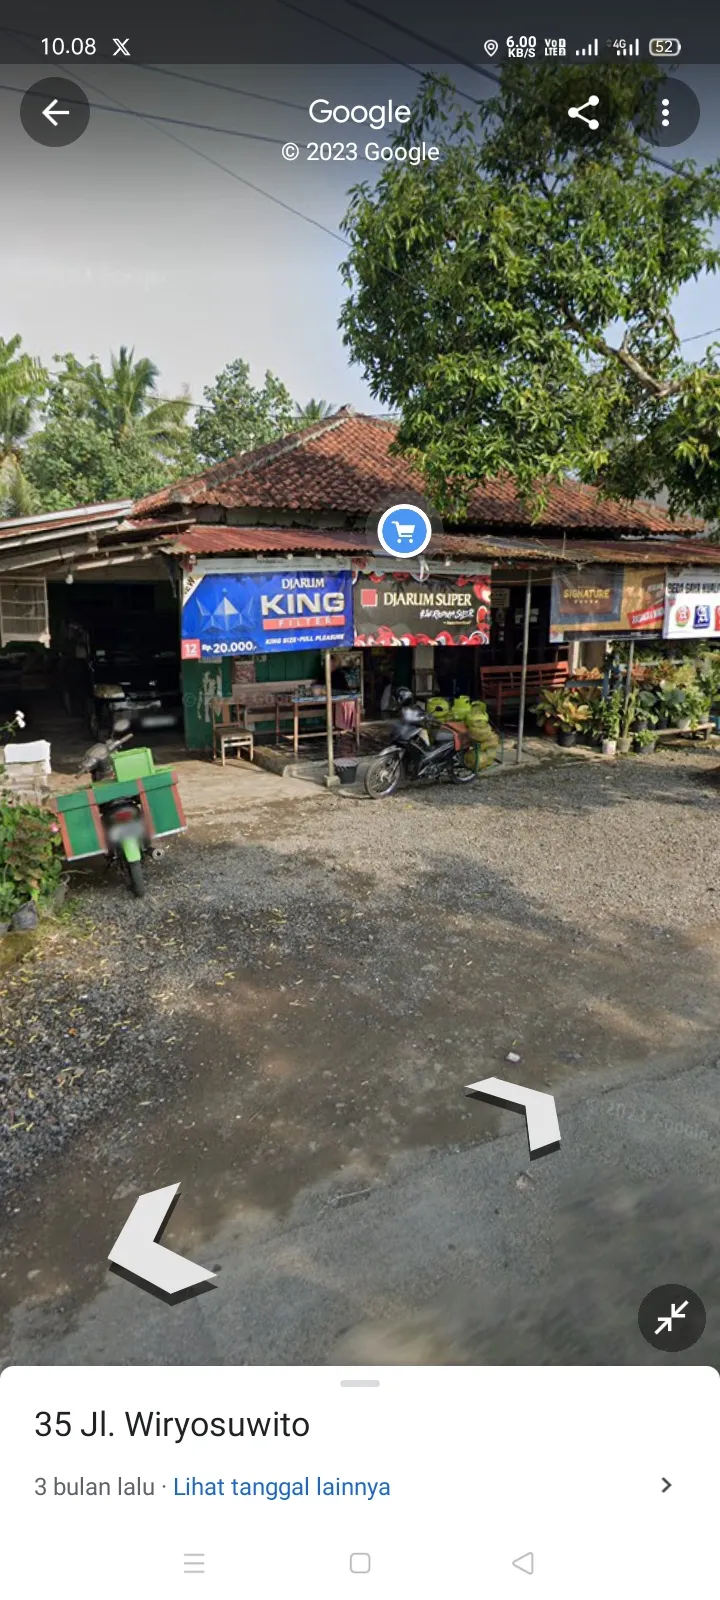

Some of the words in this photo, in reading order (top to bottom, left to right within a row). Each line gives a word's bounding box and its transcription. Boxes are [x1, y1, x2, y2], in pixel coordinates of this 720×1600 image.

[281, 577, 325, 590] DJARUM
[563, 588, 611, 599] SIGNATURE
[260, 592, 345, 616] KING
[383, 592, 434, 607] DJARUM
[435, 594, 472, 606] SUPER
[278, 618, 333, 628] FILTER
[265, 637, 281, 645] KING
[184, 644, 197, 655] 12
